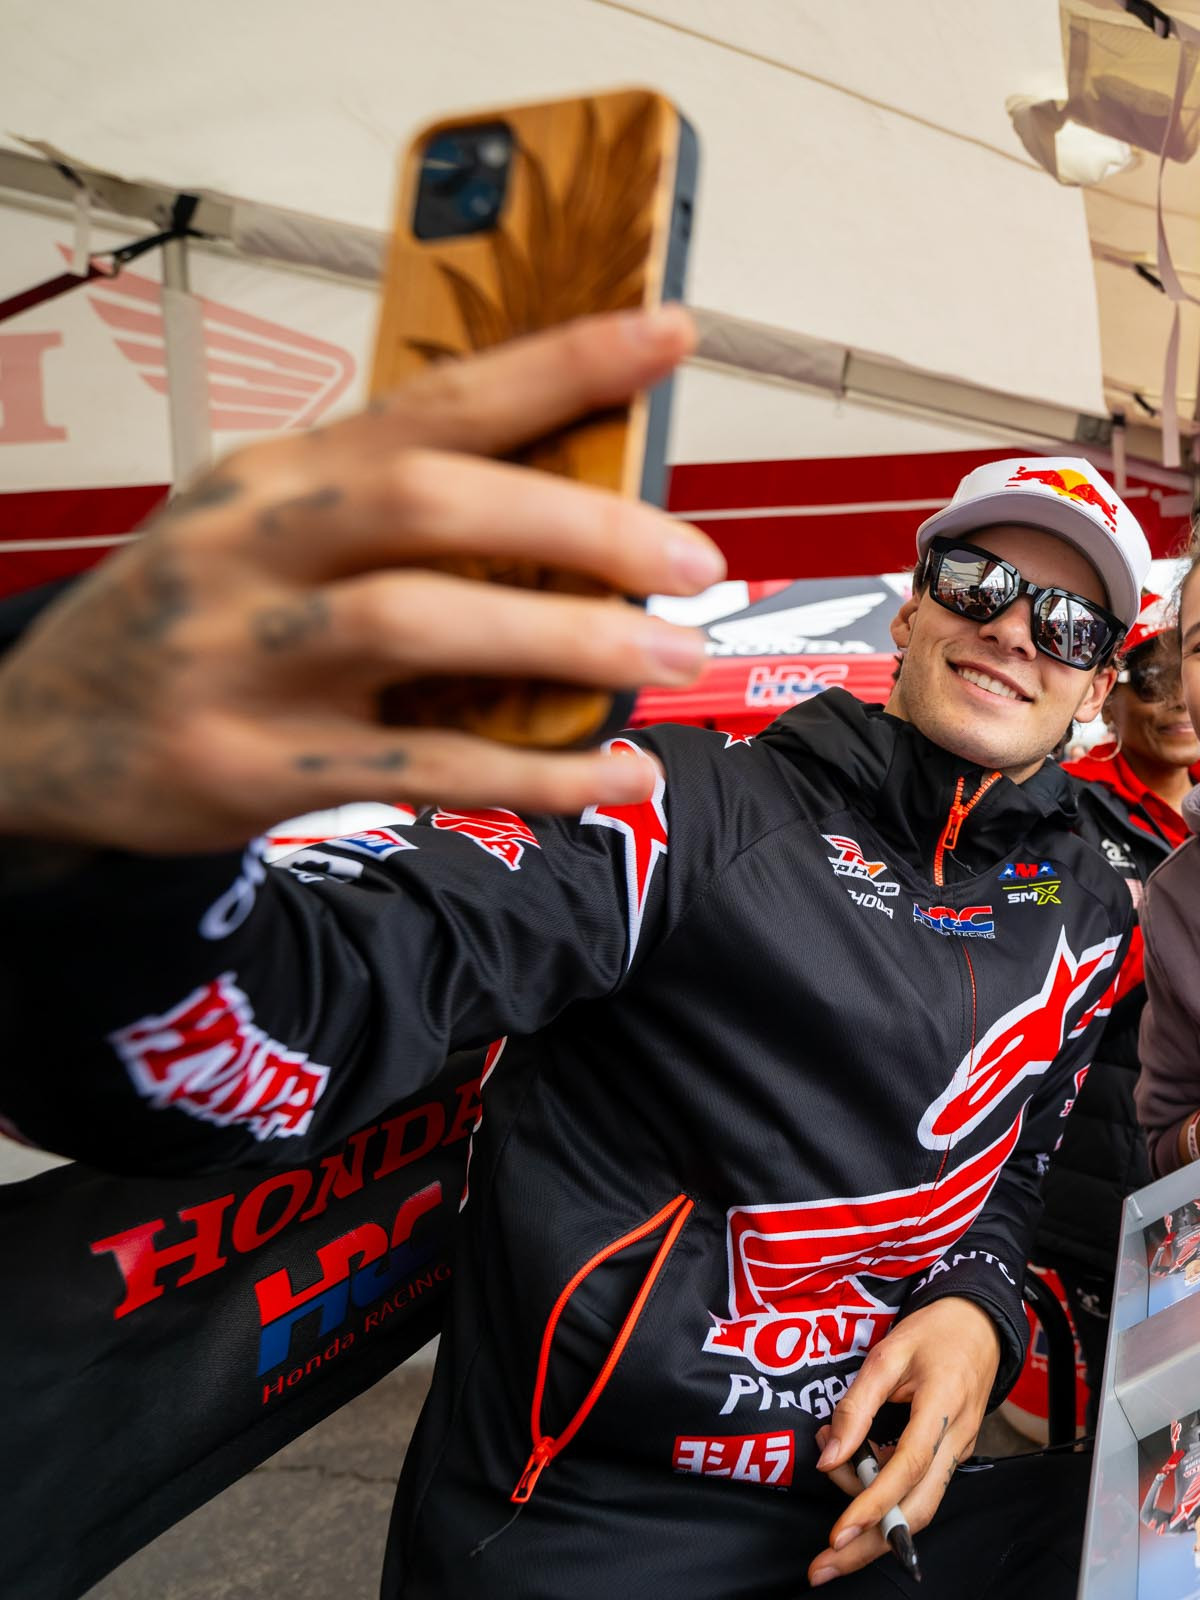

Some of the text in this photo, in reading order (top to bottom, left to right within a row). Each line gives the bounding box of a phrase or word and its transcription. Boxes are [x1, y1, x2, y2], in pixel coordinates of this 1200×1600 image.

[998, 861, 1058, 880] AMA
[1007, 885, 1062, 905] SMX
[90, 1077, 483, 1321] HONDA
[253, 1179, 443, 1378] HRC
[262, 1262, 452, 1406] Honda RACING
